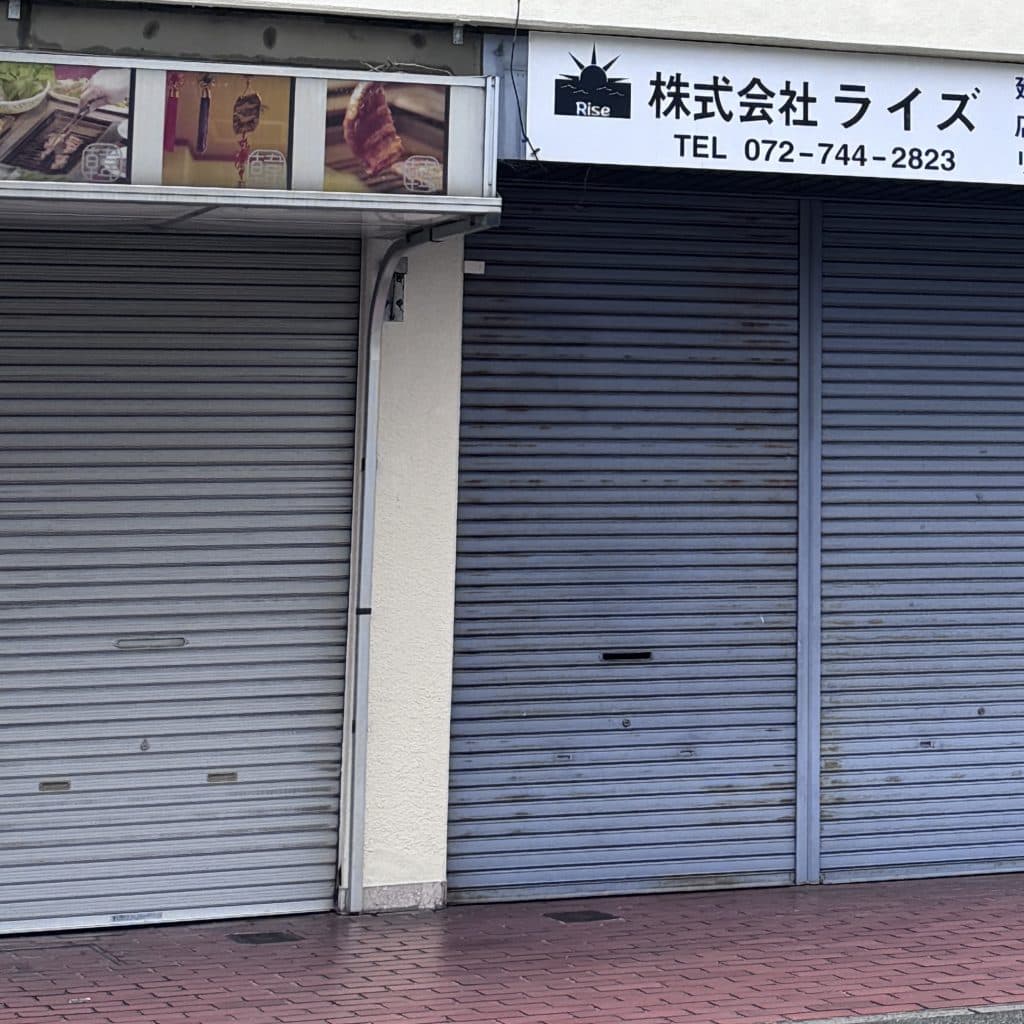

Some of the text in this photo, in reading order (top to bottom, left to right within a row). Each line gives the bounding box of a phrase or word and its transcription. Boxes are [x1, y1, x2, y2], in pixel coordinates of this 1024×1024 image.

[575, 101, 611, 117] Rise
[674, 134, 956, 171] TEL 072-744-2823
